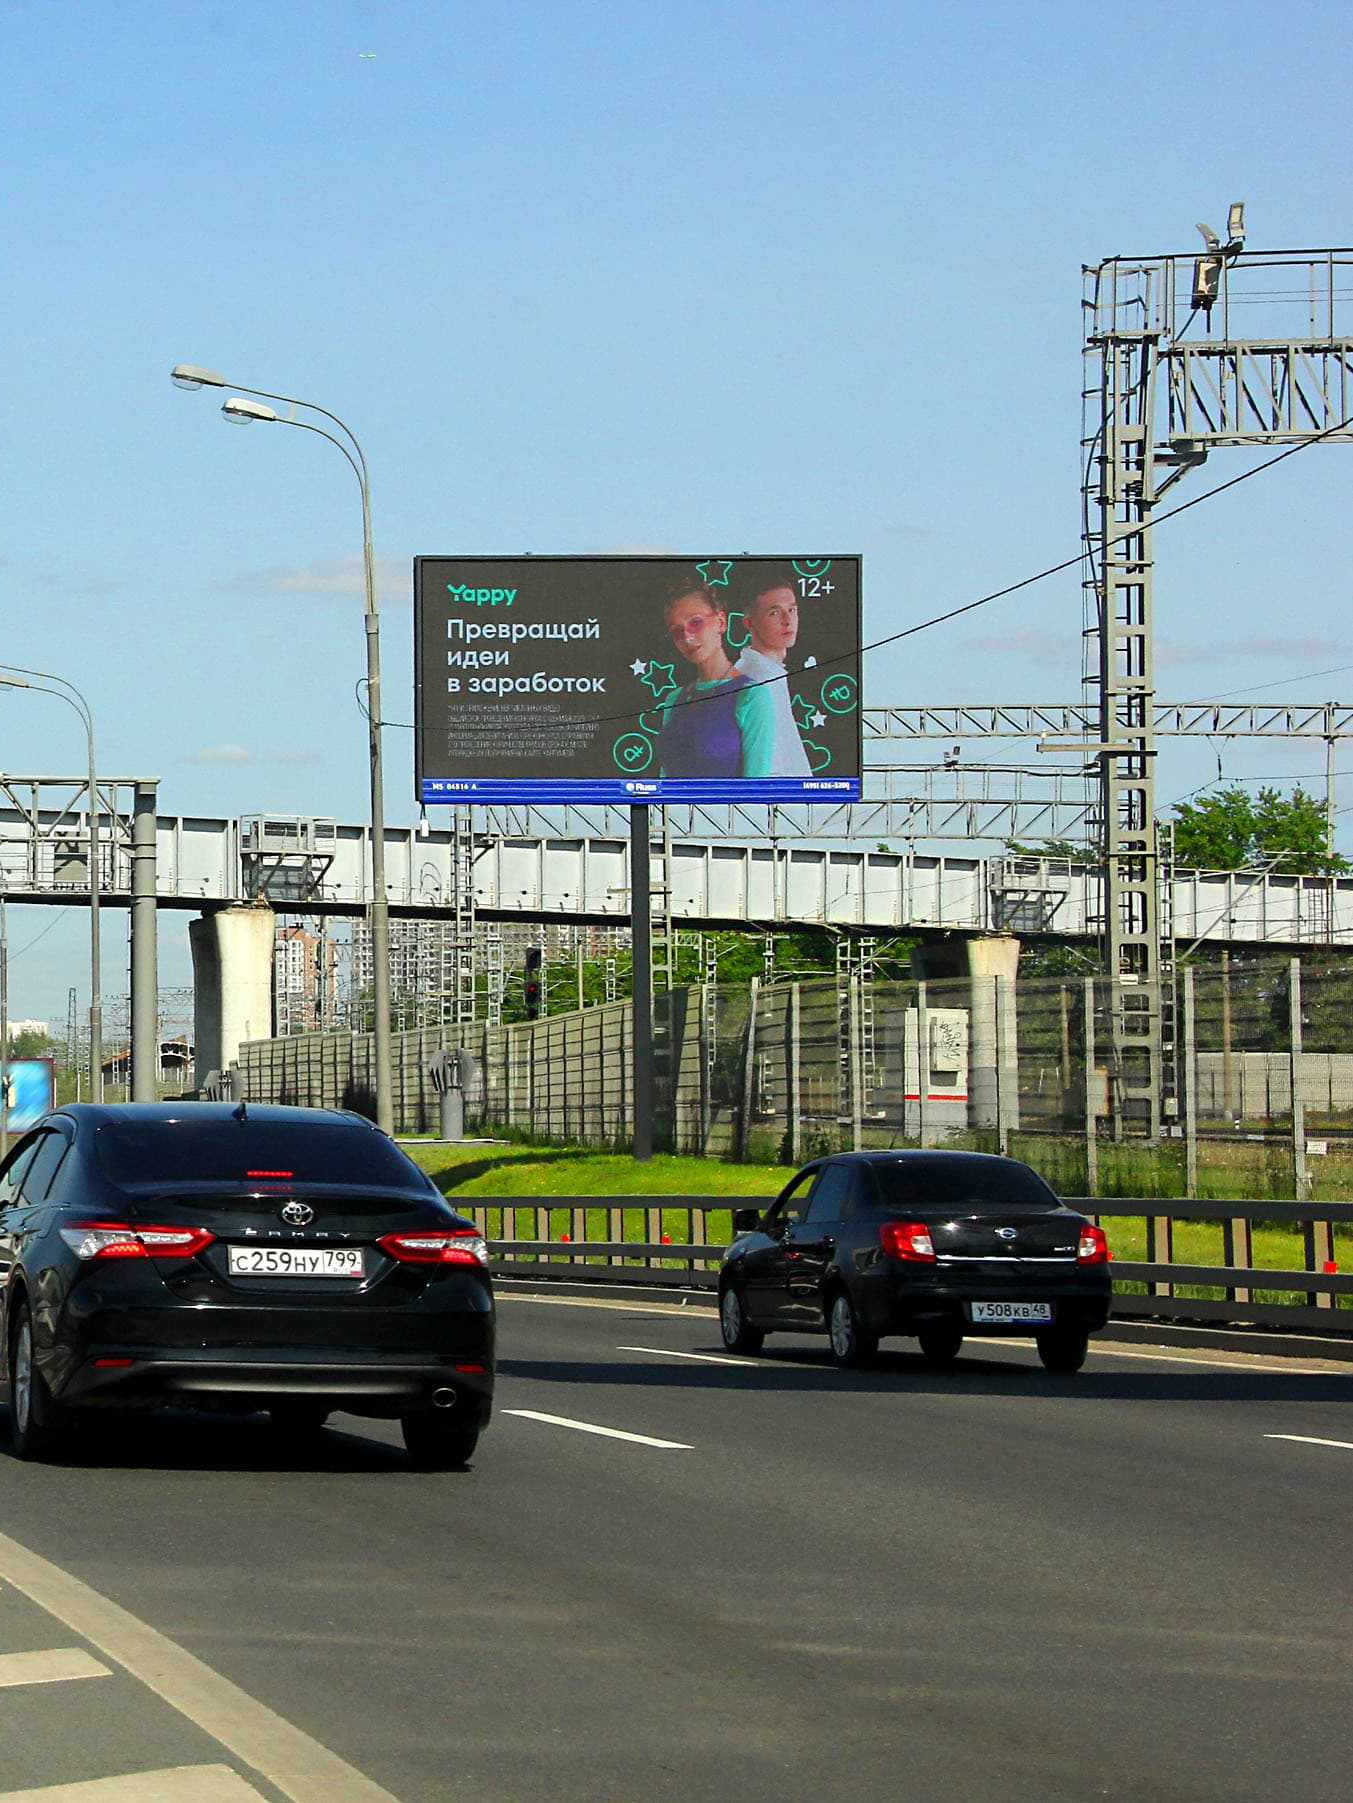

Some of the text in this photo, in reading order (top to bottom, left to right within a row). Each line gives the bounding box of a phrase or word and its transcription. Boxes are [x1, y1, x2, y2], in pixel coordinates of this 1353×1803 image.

[447, 584, 518, 606] Yappy
[797, 577, 836, 597] 12+
[447, 618, 600, 644] Превращай
[447, 650, 510, 669] идеи
[447, 671, 607, 697] в заработок
[236, 1251, 357, 1272] С259НУ 799
[977, 1303, 1046, 1318] У508КВ 48
